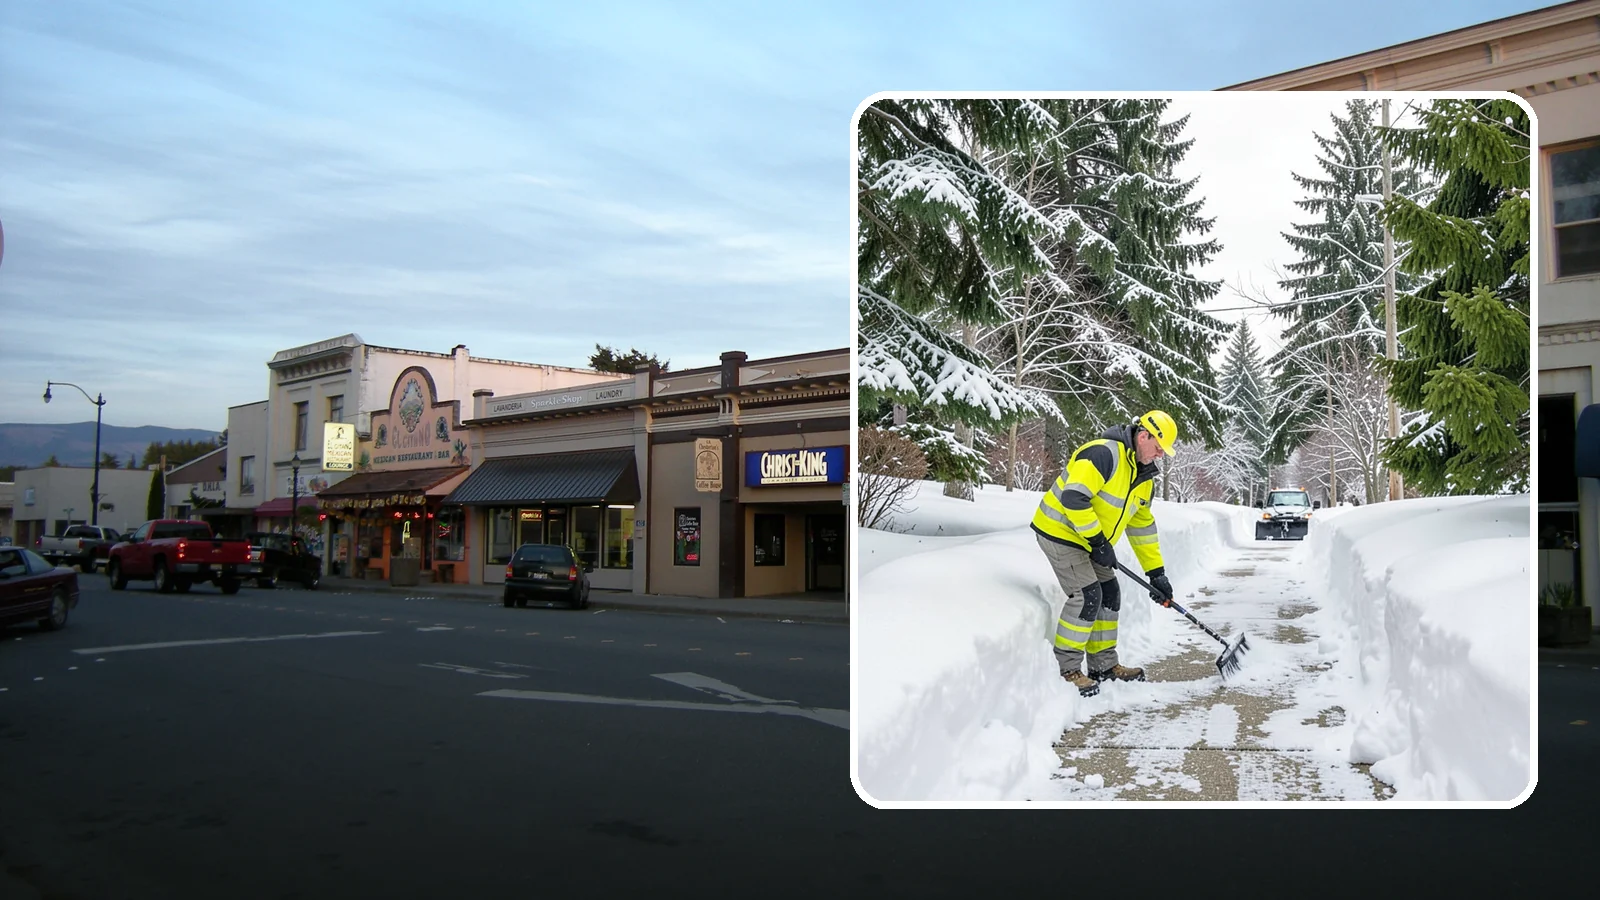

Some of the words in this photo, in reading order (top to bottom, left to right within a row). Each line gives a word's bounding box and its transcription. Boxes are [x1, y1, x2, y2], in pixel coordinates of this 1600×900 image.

[562, 394, 582, 406] Shop
[595, 389, 623, 400] LAUNDRY
[493, 402, 522, 412] LAVANDERIA
[373, 454, 396, 464] MEXICAN
[397, 451, 433, 462] RESTAURANT
[438, 450, 450, 459] BAR
[760, 452, 797, 478] CHRIST
[799, 450, 827, 476] KING
